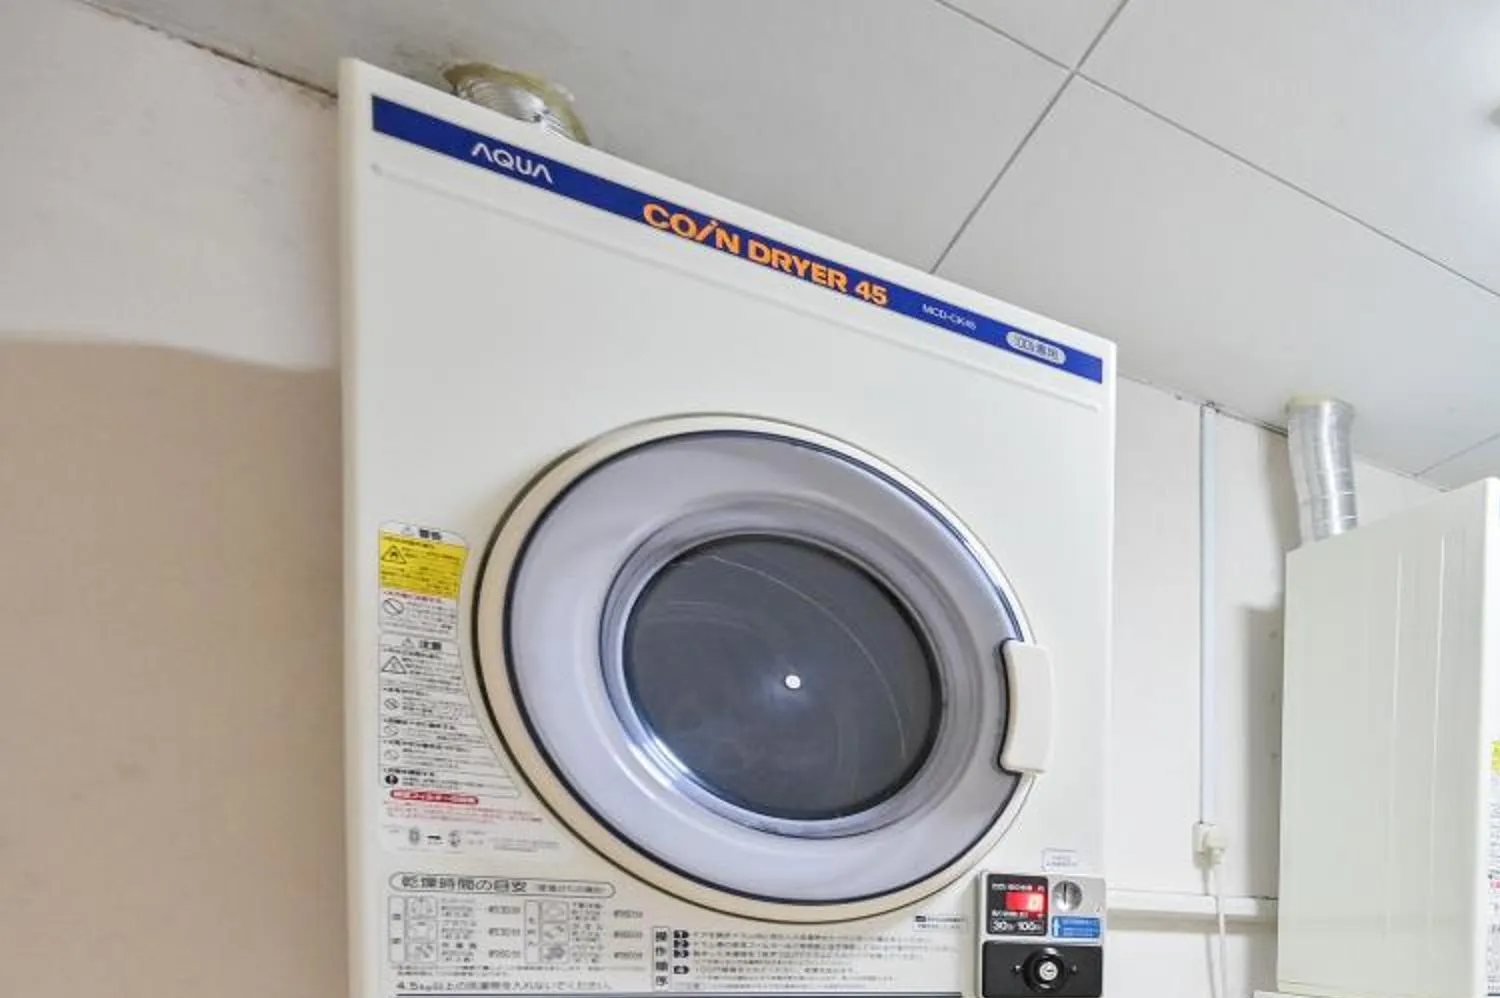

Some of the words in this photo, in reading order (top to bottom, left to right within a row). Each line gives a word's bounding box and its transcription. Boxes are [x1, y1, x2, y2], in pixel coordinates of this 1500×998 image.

[471, 142, 553, 184] AQUA
[747, 239, 848, 294] DRYER
[854, 280, 889, 307] 45
[402, 876, 527, 894] 乾燥時間の目安
